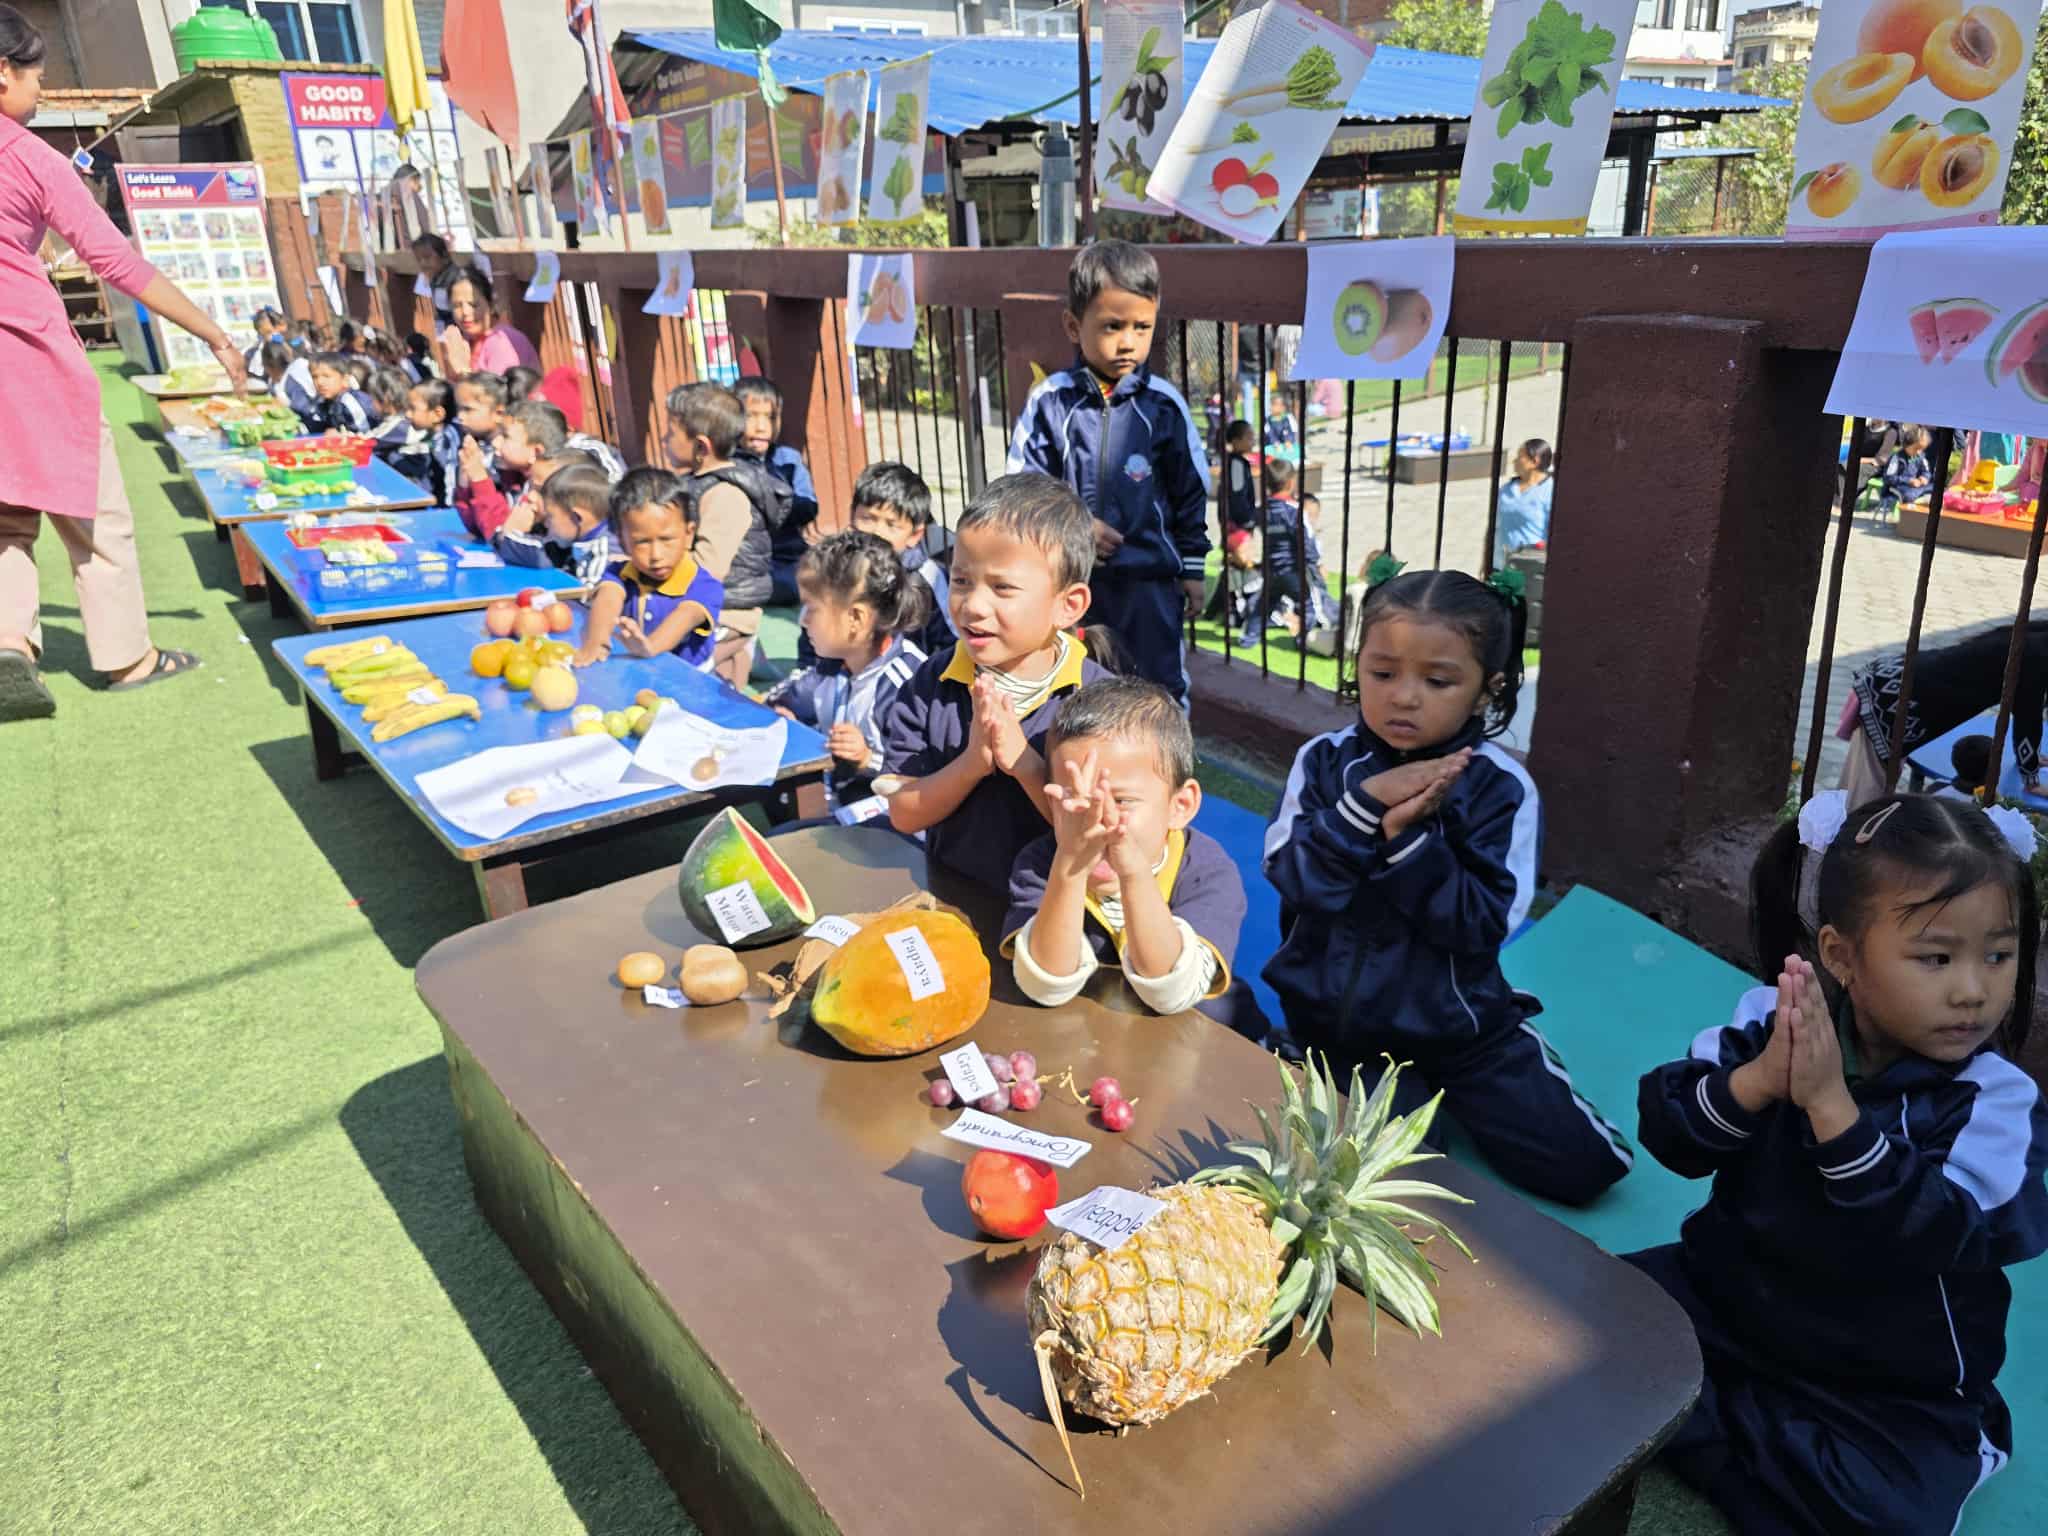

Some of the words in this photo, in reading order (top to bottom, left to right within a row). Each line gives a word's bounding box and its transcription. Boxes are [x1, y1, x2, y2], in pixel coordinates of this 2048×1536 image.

[305, 85, 364, 102] GOOD
[301, 105, 376, 122] HABITS
[716, 896, 742, 933] Melon
[735, 887, 761, 928] Water
[901, 935, 931, 987] Papaya
[956, 1051, 983, 1094] Grapes
